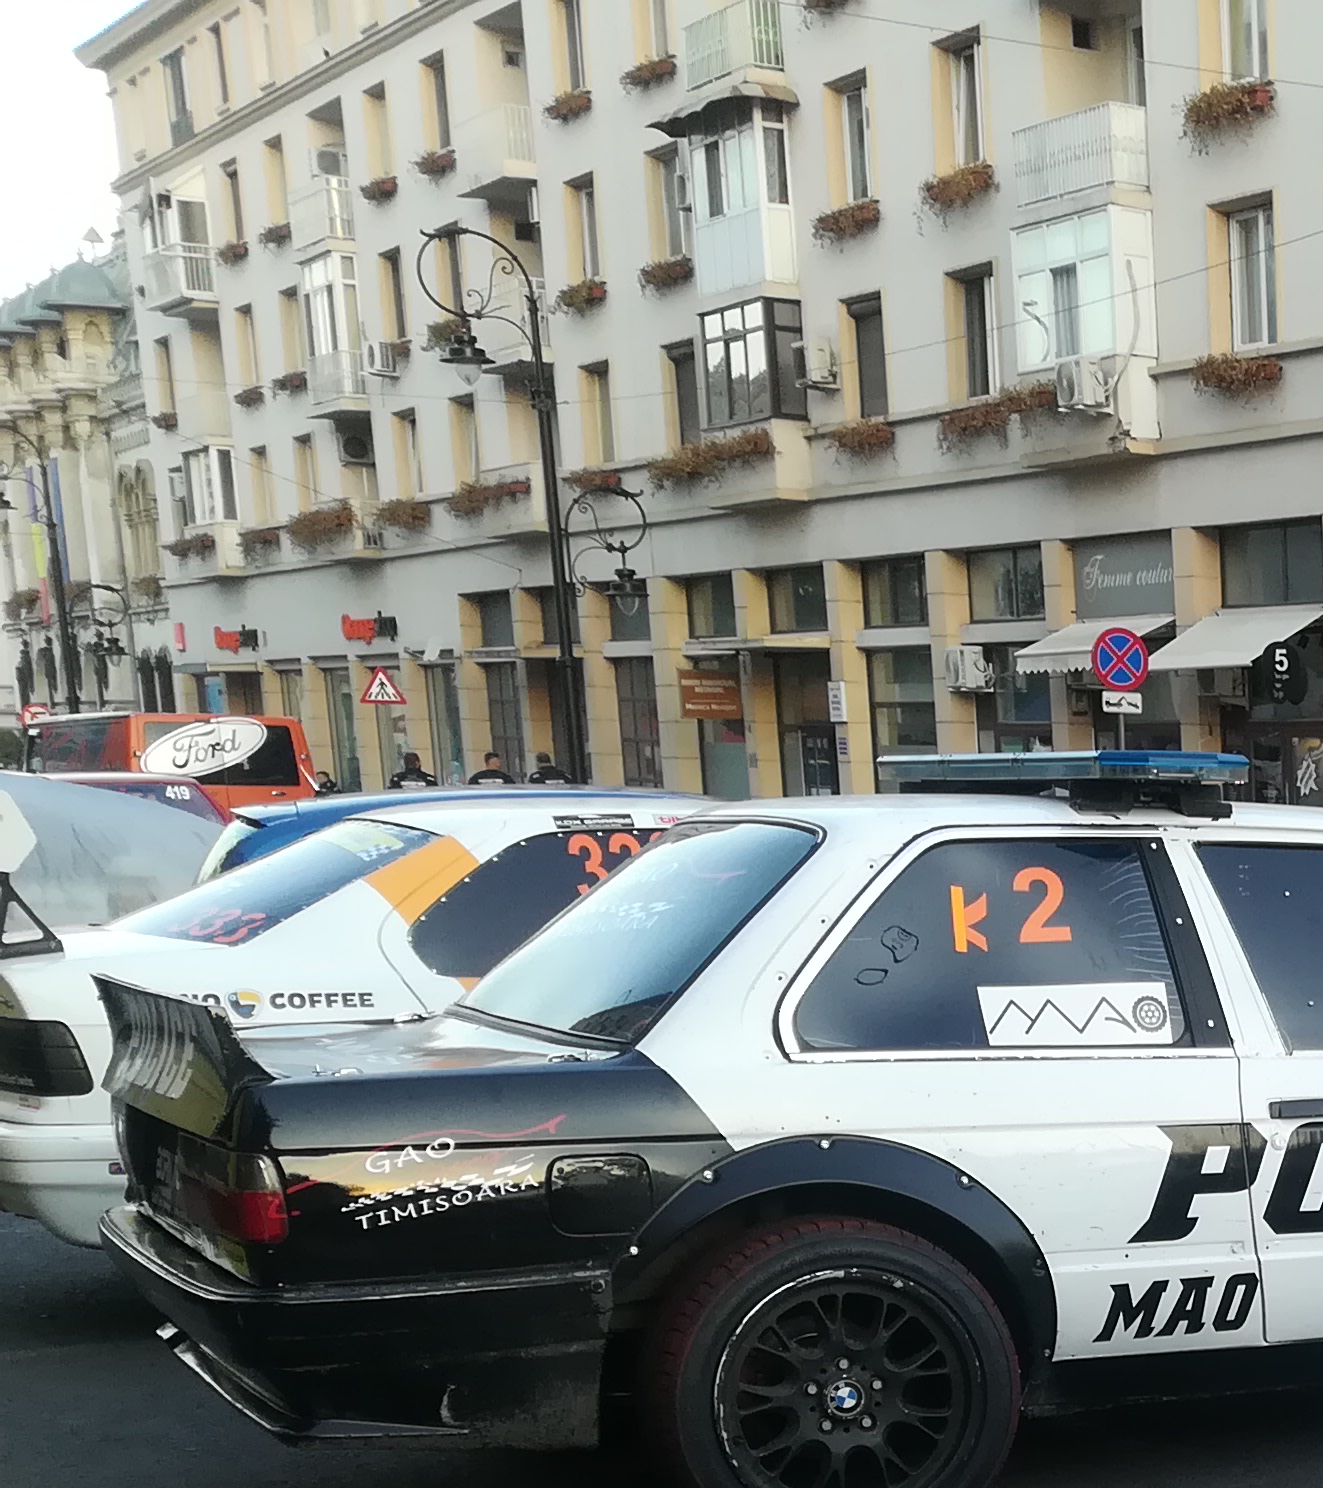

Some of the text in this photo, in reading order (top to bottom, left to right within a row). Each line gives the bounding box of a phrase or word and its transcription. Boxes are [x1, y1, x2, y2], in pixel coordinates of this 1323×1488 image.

[1083, 555, 1133, 602] Femme
[1275, 649, 1289, 671] 5
[172, 728, 242, 769] Ford
[165, 785, 190, 800] 419
[1011, 866, 1072, 944] 2
[269, 991, 375, 1010] COFFEE
[365, 1137, 455, 1174] GAO
[355, 1174, 539, 1230] TIMISOARA
[1092, 1272, 1260, 1343] MAO
